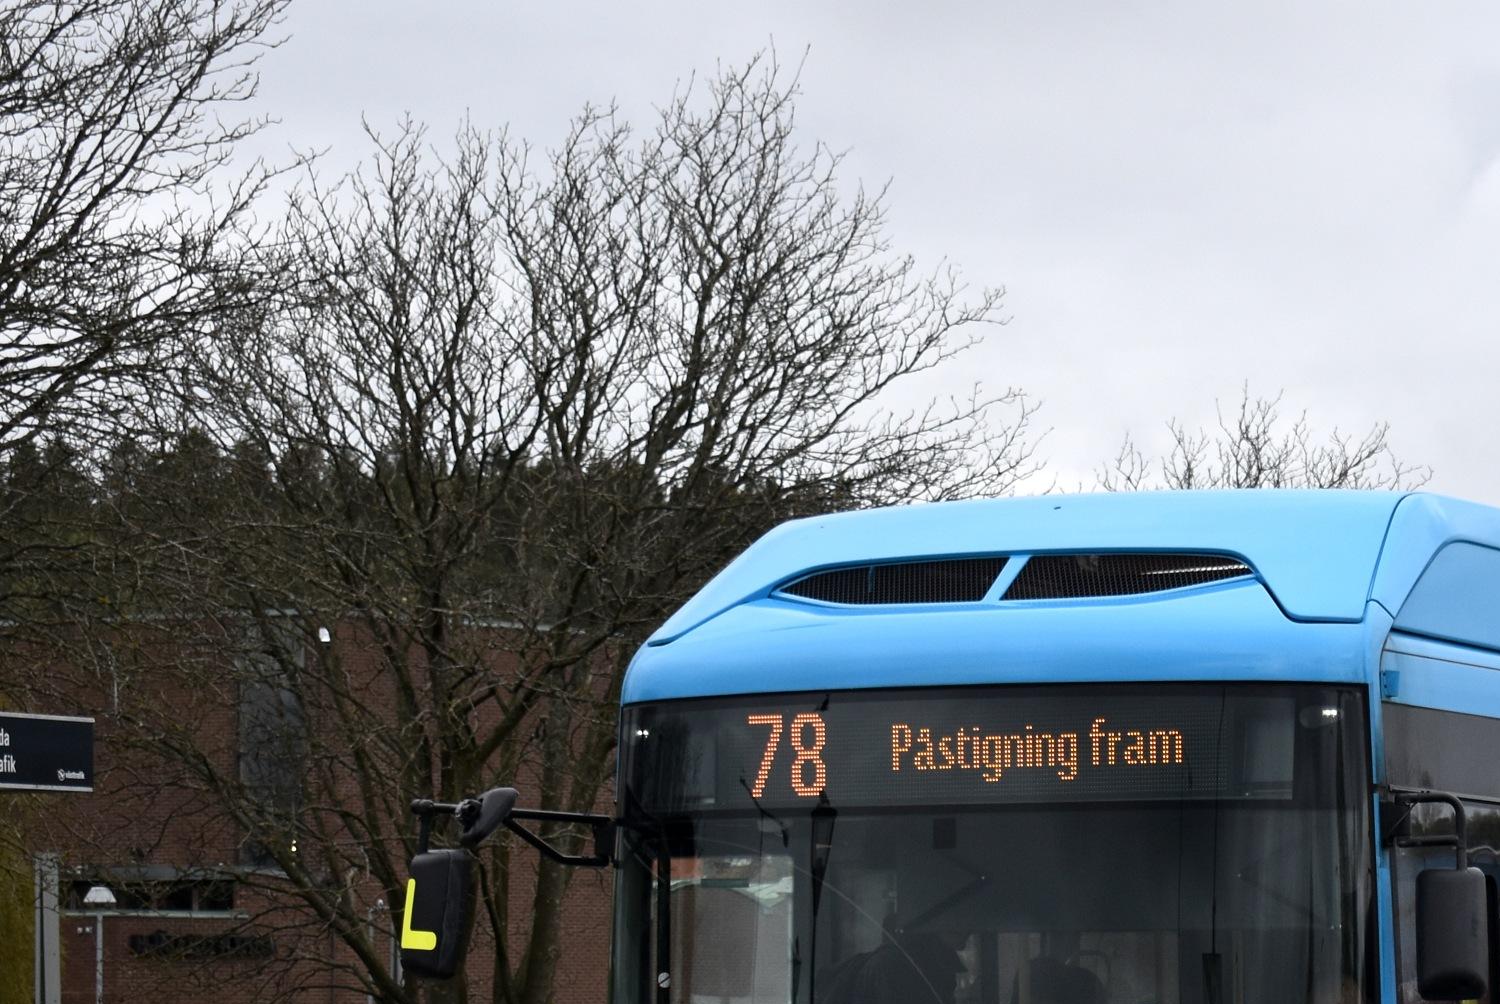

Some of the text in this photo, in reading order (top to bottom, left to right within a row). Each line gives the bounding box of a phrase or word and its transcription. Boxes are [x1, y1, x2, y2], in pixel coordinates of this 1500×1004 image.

[747, 713, 1183, 798] 78 Påstigning fram
